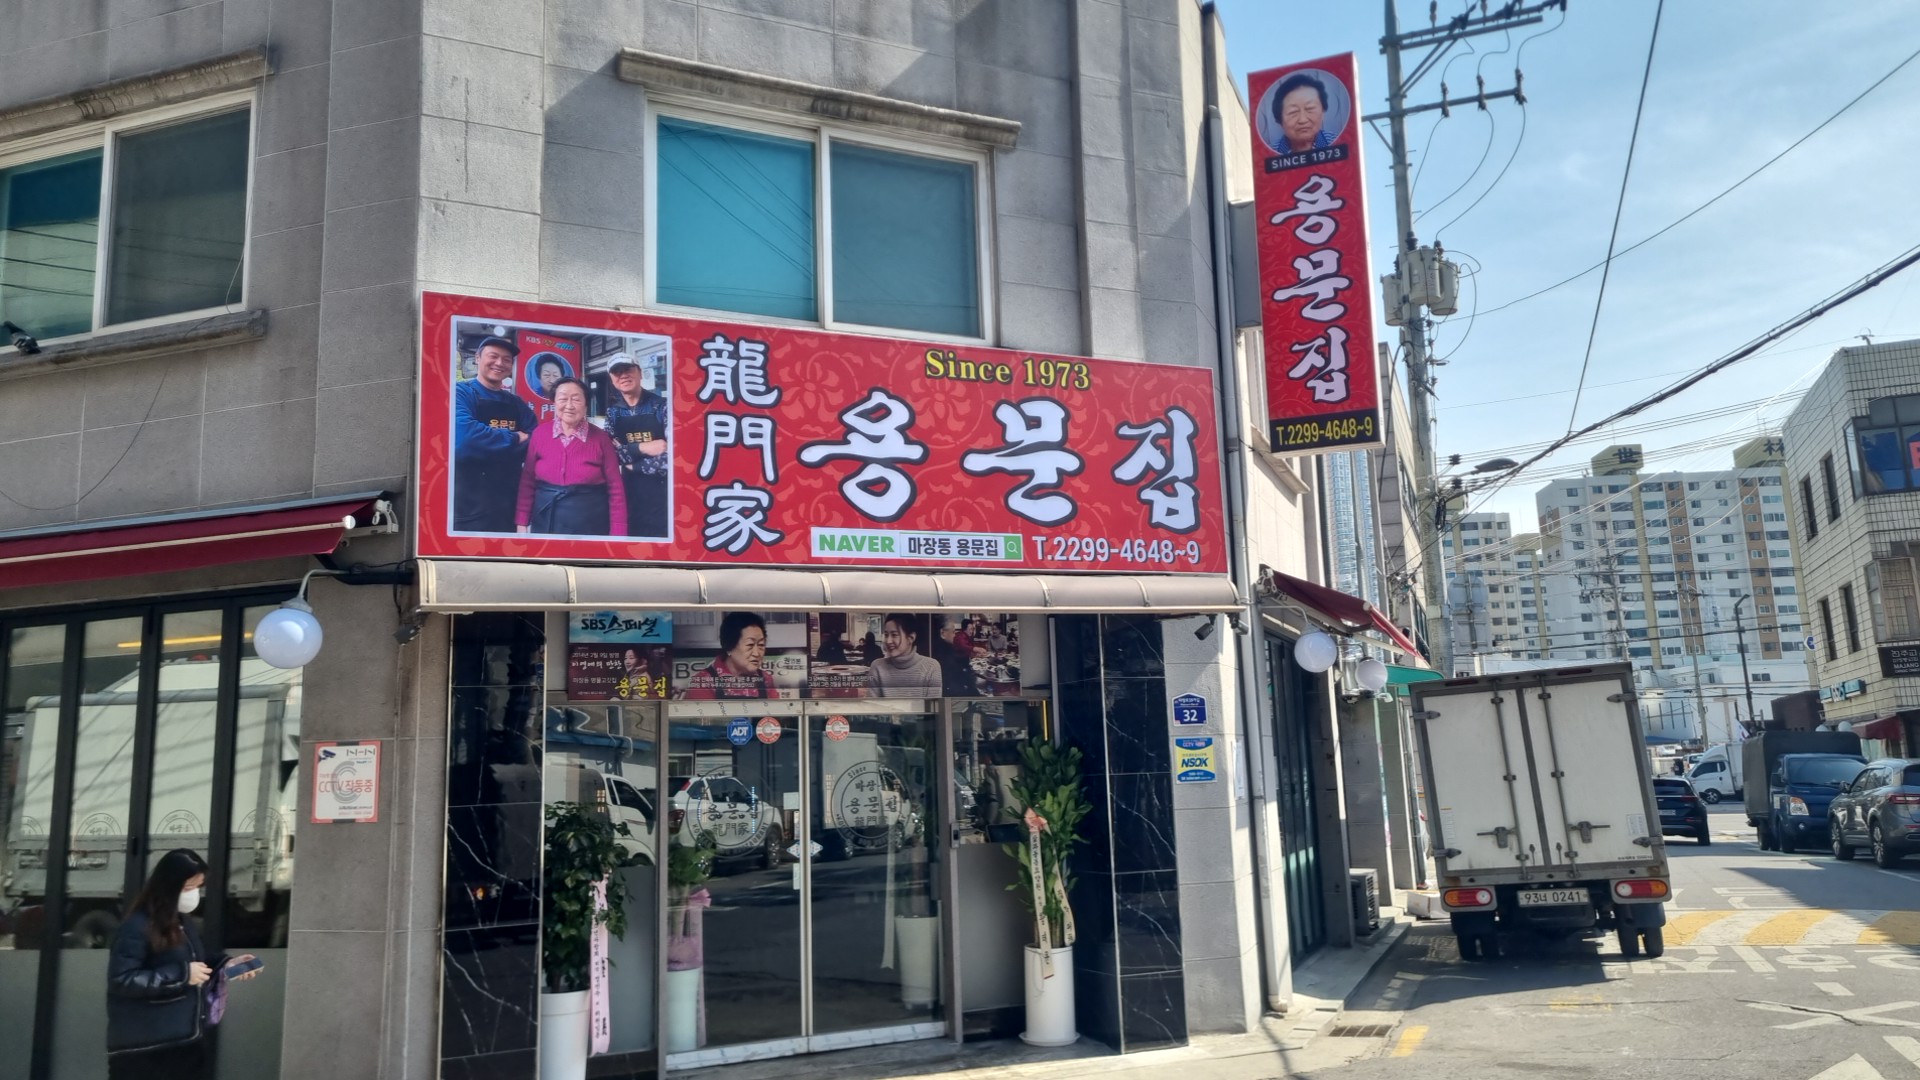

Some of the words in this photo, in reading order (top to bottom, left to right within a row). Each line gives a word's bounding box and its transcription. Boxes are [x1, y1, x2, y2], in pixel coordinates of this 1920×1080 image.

[1271, 155, 1307, 170] SINCE
[1311, 148, 1341, 163] 1973
[1270, 175, 1352, 403] 용문집
[925, 349, 1012, 384] Since
[1023, 358, 1090, 390] 1973
[1276, 417, 1373, 446] T.2299-4648~9
[698, 334, 783, 554] 龍門家
[798, 388, 1200, 533] 용문집
[818, 533, 895, 555] NAVER
[907, 537, 951, 556] 마장동
[956, 538, 999, 557] 용문집
[1032, 535, 1200, 564] T.2299-4648~9
[614, 674, 667, 698] 용문집
[1183, 709, 1198, 721] 32
[731, 727, 748, 737] ADT
[1181, 757, 1208, 768] NSOK
[319, 781, 344, 793] CCTV
[345, 779, 374, 793] 작동중
[1552, 891, 1581, 903] 0241
